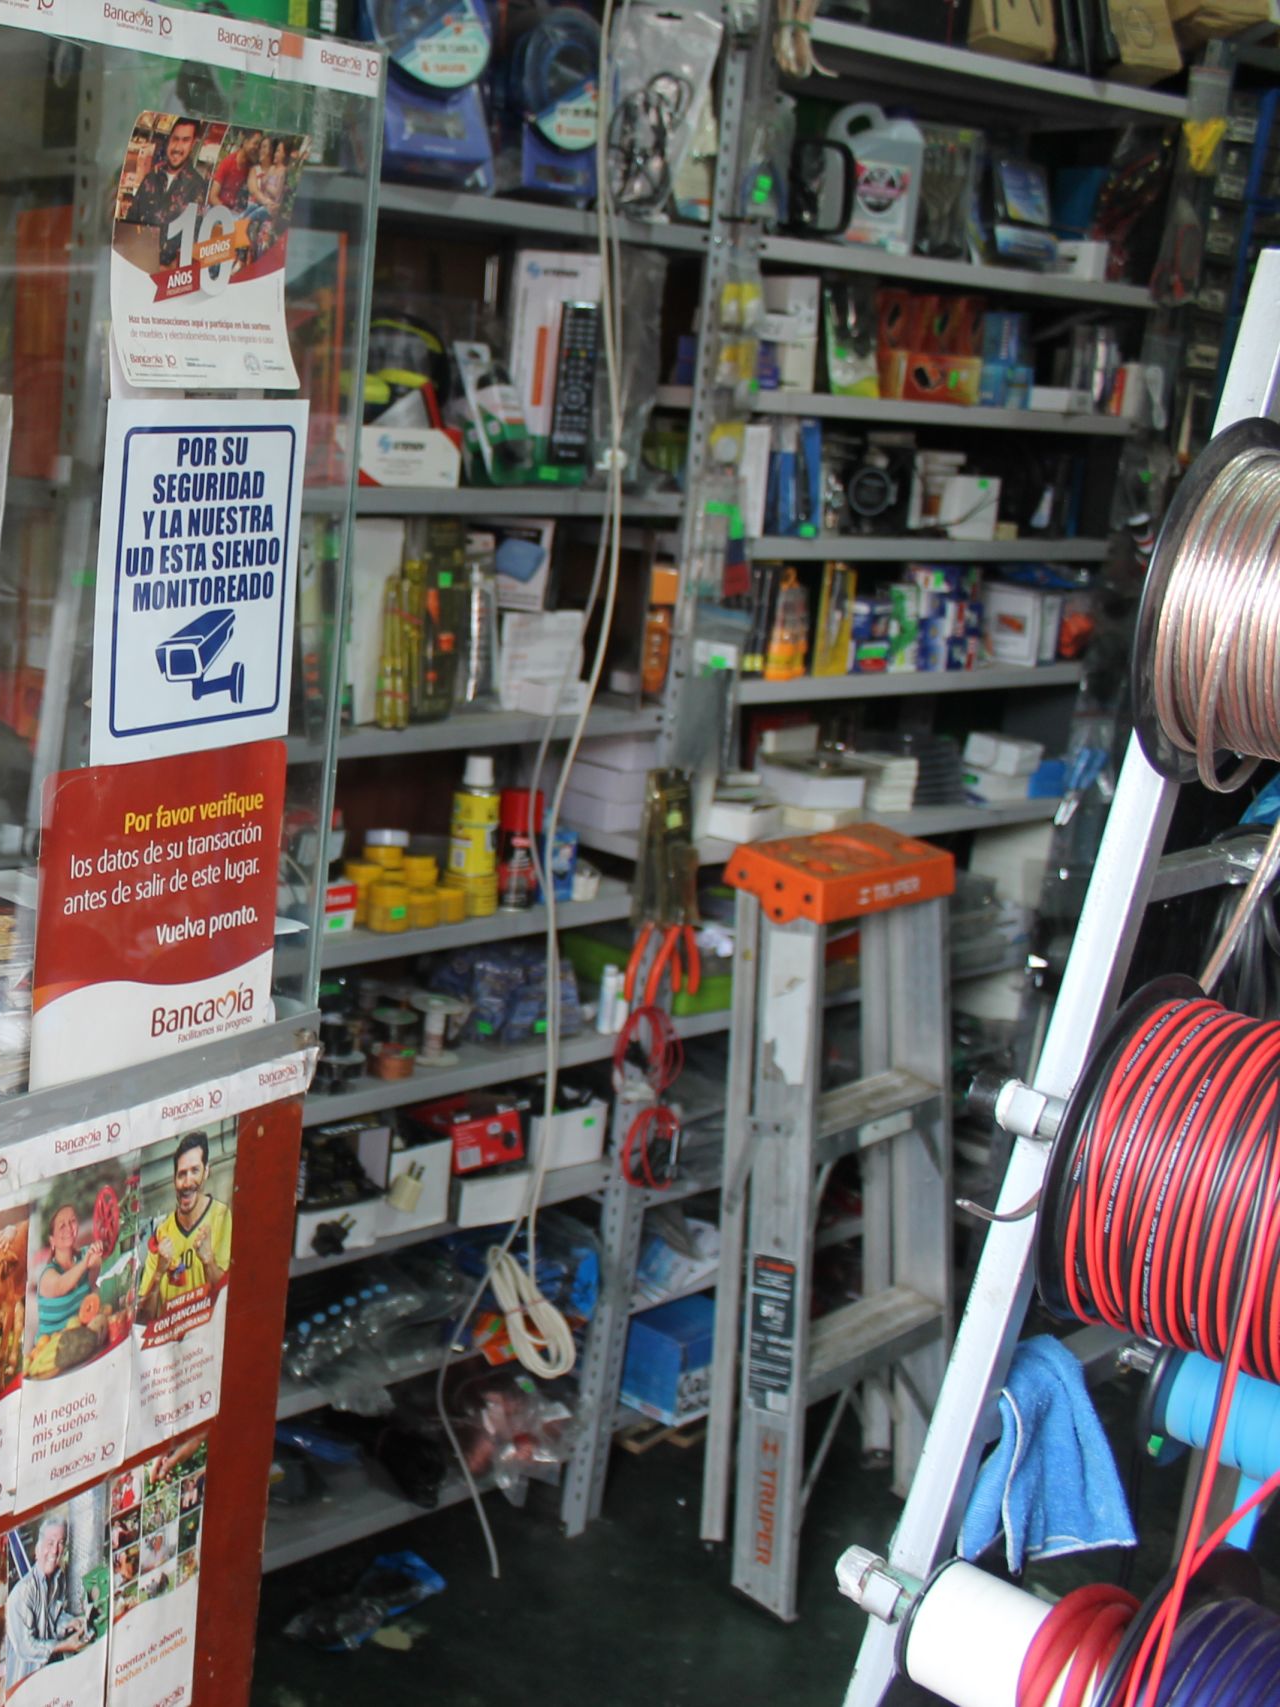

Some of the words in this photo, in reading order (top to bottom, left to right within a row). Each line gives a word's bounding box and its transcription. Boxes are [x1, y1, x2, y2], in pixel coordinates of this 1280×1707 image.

[158, 15, 172, 37] 10
[268, 38, 281, 58] 10
[366, 58, 379, 77] 10
[167, 270, 193, 290] AÑOS
[177, 437, 216, 467] POR
[222, 436, 248, 465] SU
[153, 471, 265, 504] SEGURIDAD
[143, 510, 155, 540] Y
[159, 510, 183, 539] LA
[188, 505, 273, 537] NUESTRA
[125, 547, 154, 577] UD
[160, 543, 206, 574] ESTA
[212, 537, 280, 571] SIENDO
[132, 571, 275, 612] MONITOREADO
[124, 812, 152, 834] Por
[156, 804, 195, 829] favor
[200, 792, 264, 821] verifique
[70, 854, 93, 880] los
[97, 848, 139, 874] datos
[143, 840, 163, 865] de
[167, 841, 183, 860] su
[187, 821, 262, 857] transacción
[63, 889, 107, 916] antes
[111, 882, 131, 905] de
[135, 875, 165, 900] salir
[169, 869, 187, 892] de
[192, 867, 220, 888] este
[224, 856, 260, 885] lugar.
[874, 877, 921, 903] TRUPER
[156, 915, 205, 946] Vuelva
[209, 905, 258, 939] pronto.
[177, 1026, 215, 1044] Facilitamos
[225, 1014, 253, 1033] progreso
[208, 1089, 222, 1108] 10
[106, 1122, 120, 1143] 10
[33, 1411, 48, 1428] Mi
[51, 1392, 97, 1422] negocio,
[32, 1430, 53, 1446] mis
[57, 1409, 98, 1433] sueños,
[31, 1449, 47, 1464] mi
[50, 1430, 83, 1456] futuro
[100, 1442, 115, 1462] 10
[754, 1468, 779, 1567] TRUPER
[116, 1651, 146, 1675] Cuentas
